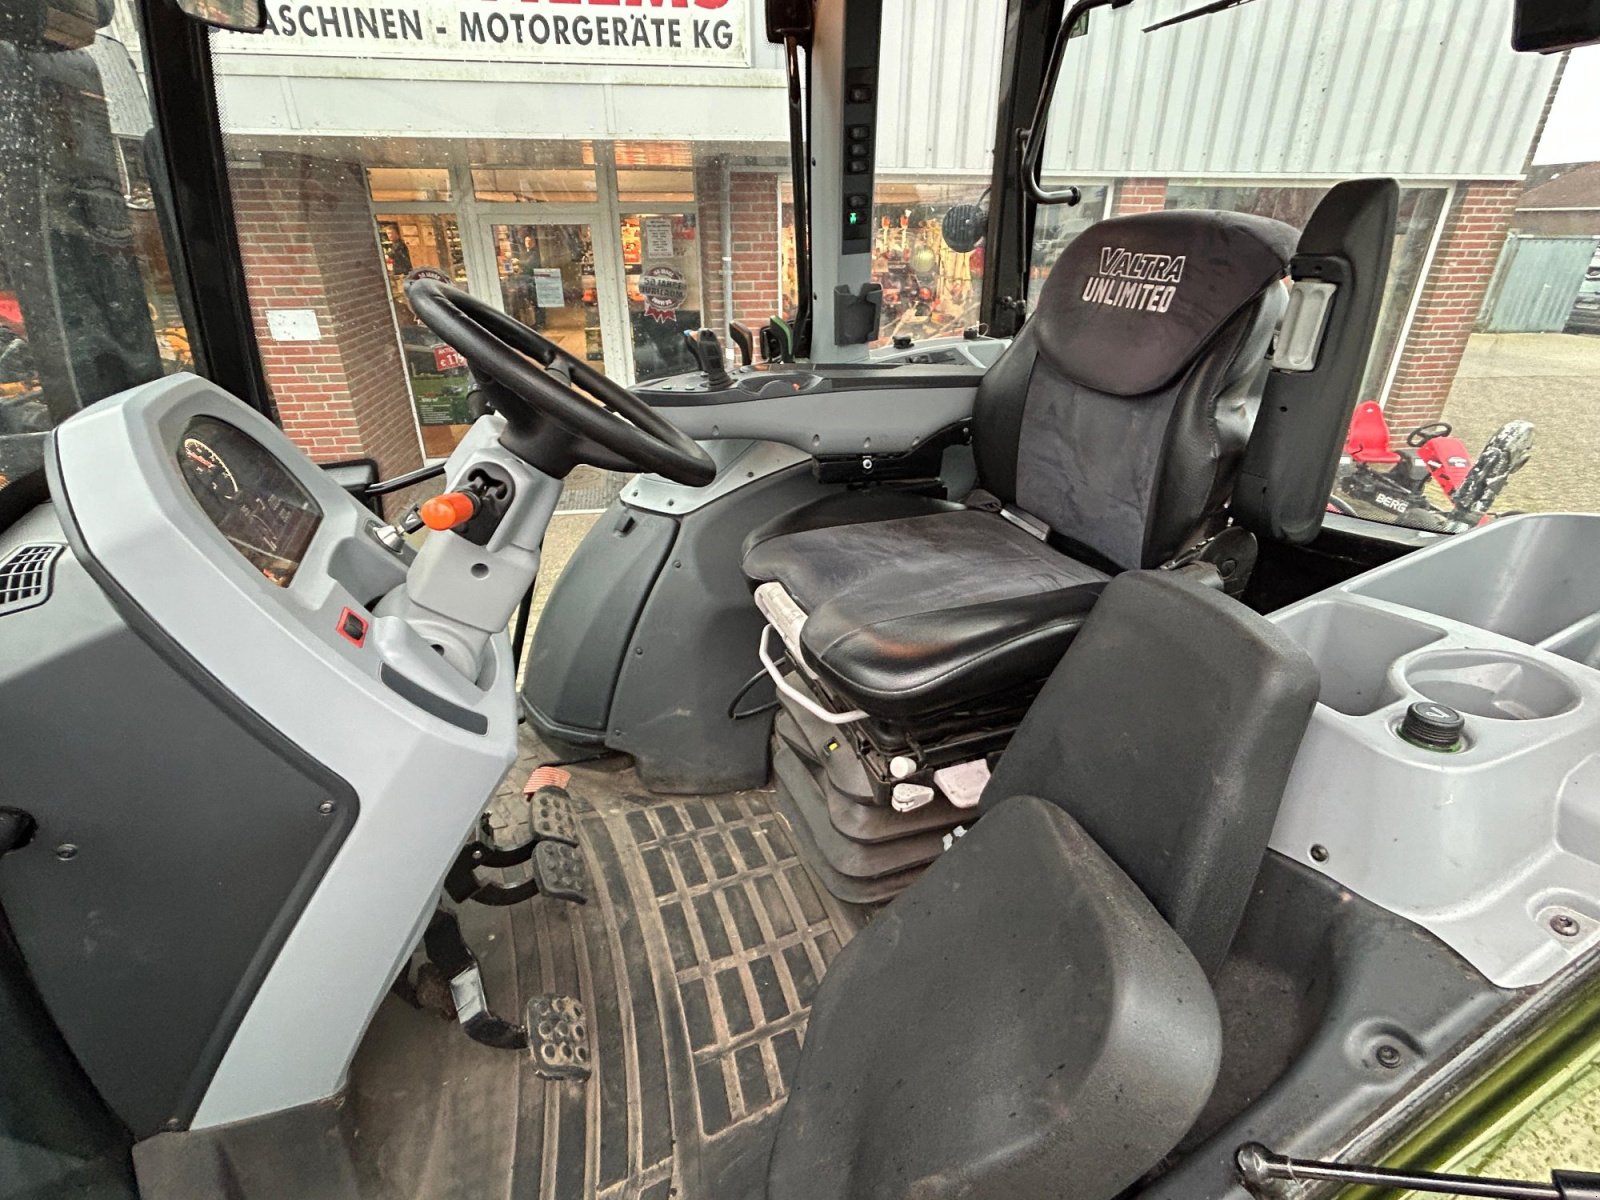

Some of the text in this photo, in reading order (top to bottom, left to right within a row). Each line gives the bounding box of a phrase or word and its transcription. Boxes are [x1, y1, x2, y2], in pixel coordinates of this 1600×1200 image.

[230, 4, 424, 41] ASCHINEN
[459, 11, 682, 48] MOTORGERÄTE
[693, 19, 733, 50] KG
[1099, 246, 1186, 283] VALTRA
[1082, 276, 1177, 313] UNLIMITED
[1375, 493, 1409, 513] BERG
